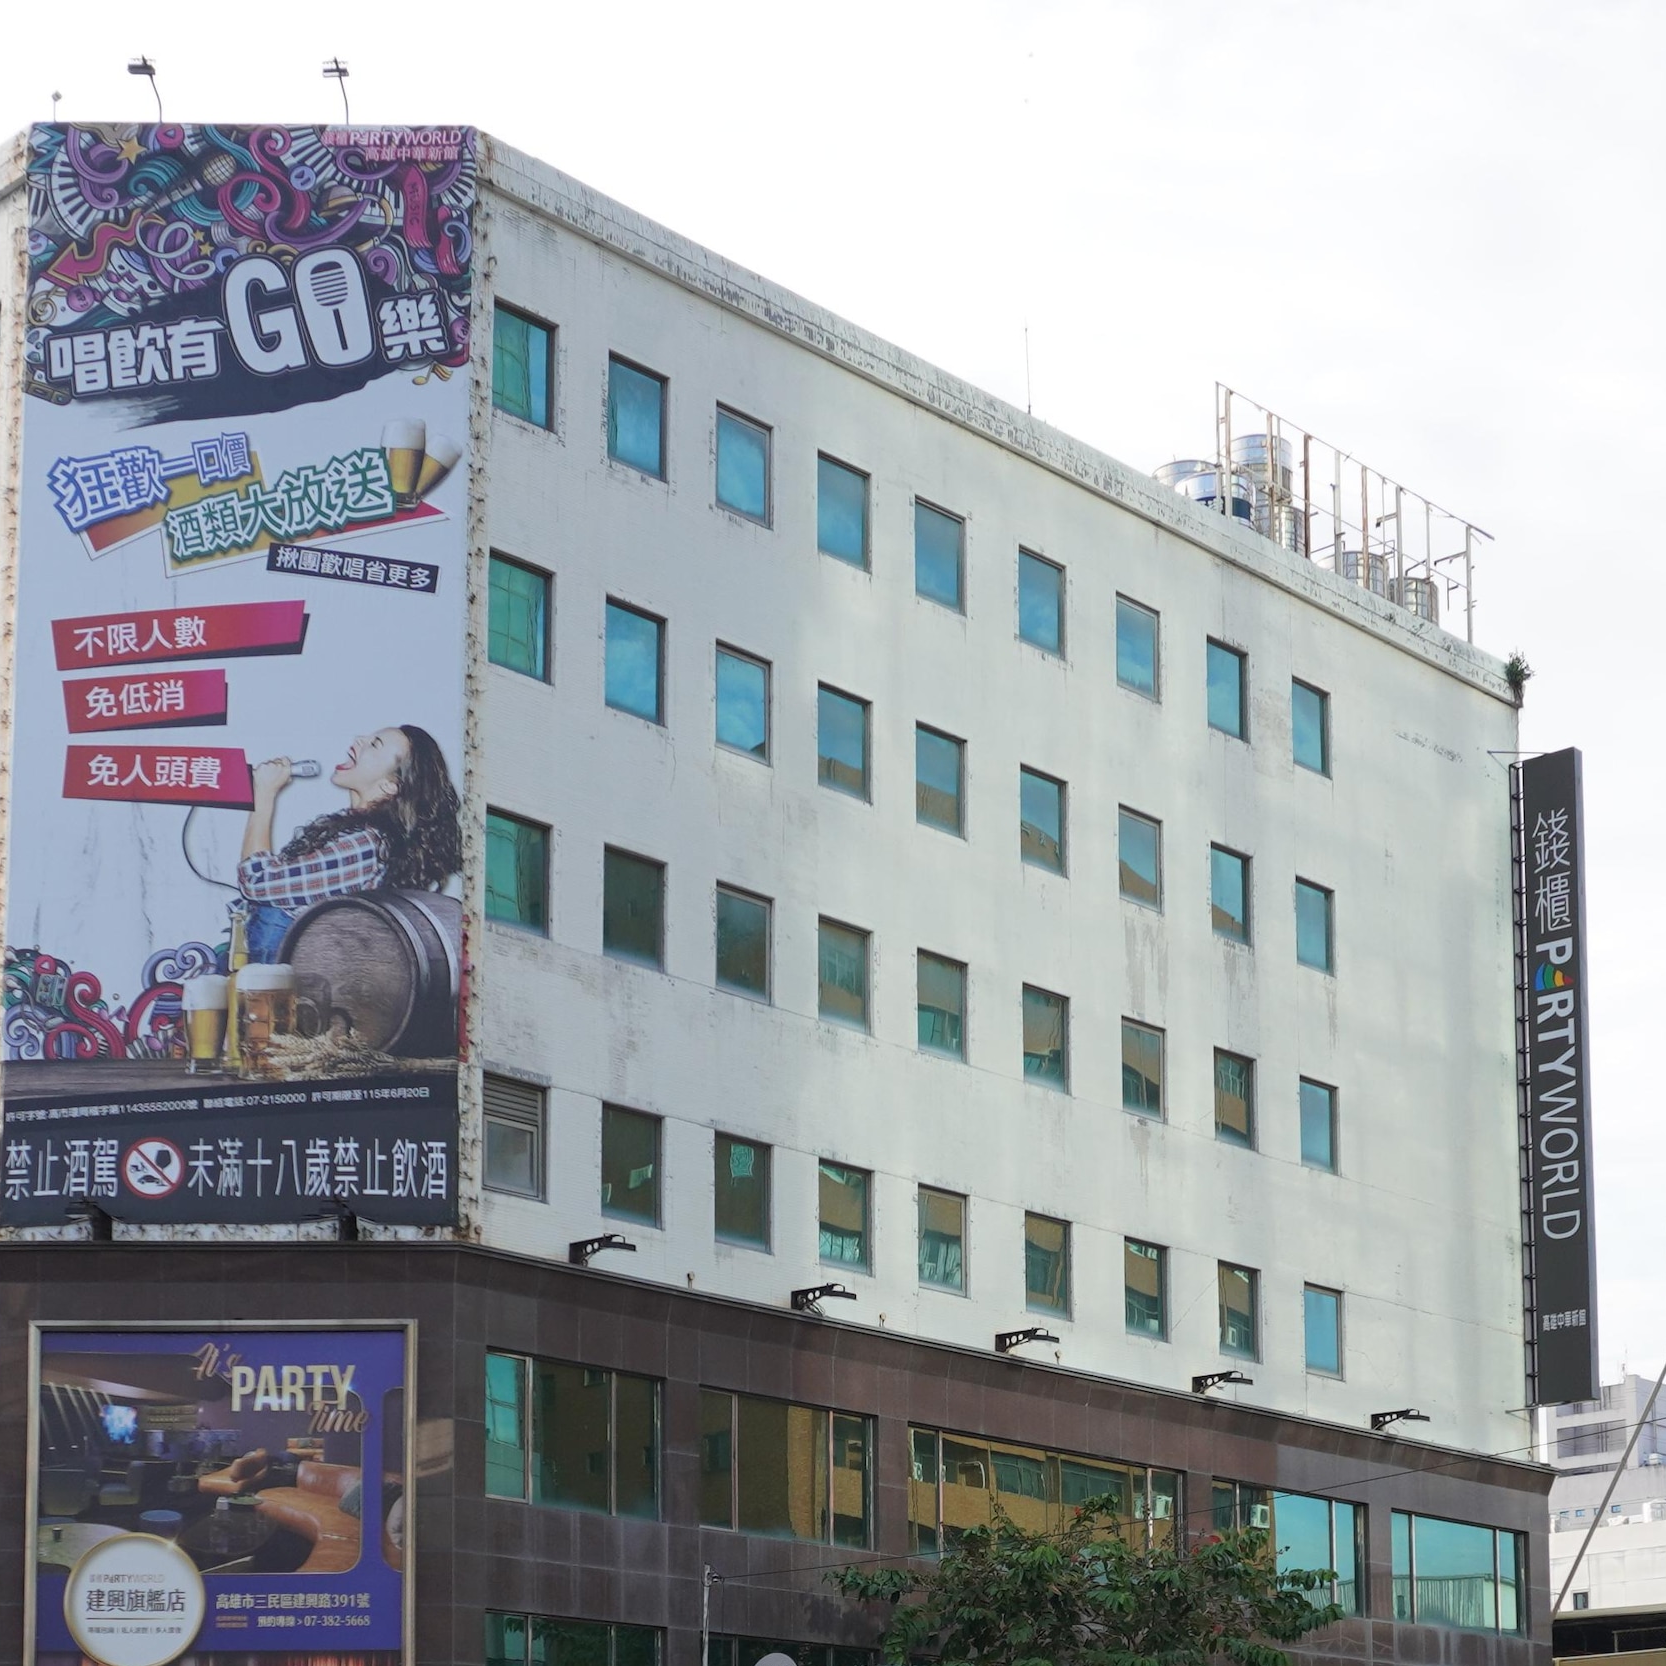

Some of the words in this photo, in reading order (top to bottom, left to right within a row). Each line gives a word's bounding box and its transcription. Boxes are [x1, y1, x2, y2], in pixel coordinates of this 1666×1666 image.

[224, 246, 375, 375] GO
[376, 292, 448, 359] 樂
[165, 449, 396, 562] 酒類大放送
[274, 546, 432, 590] 揪團歡唱省更多
[73, 616, 207, 660] 不限人數
[85, 681, 186, 720] 免低消
[87, 754, 222, 791] 免人頭費
[1533, 807, 1572, 931] 錢櫃
[5, 1138, 119, 1200] 禁止酒駕
[188, 1137, 448, 1200] 未滿十八歲禁止飲酒
[231, 1364, 356, 1412] PARTY
[308, 1400, 369, 1435] Time
[86, 1588, 186, 1612] 建興旗艦店
